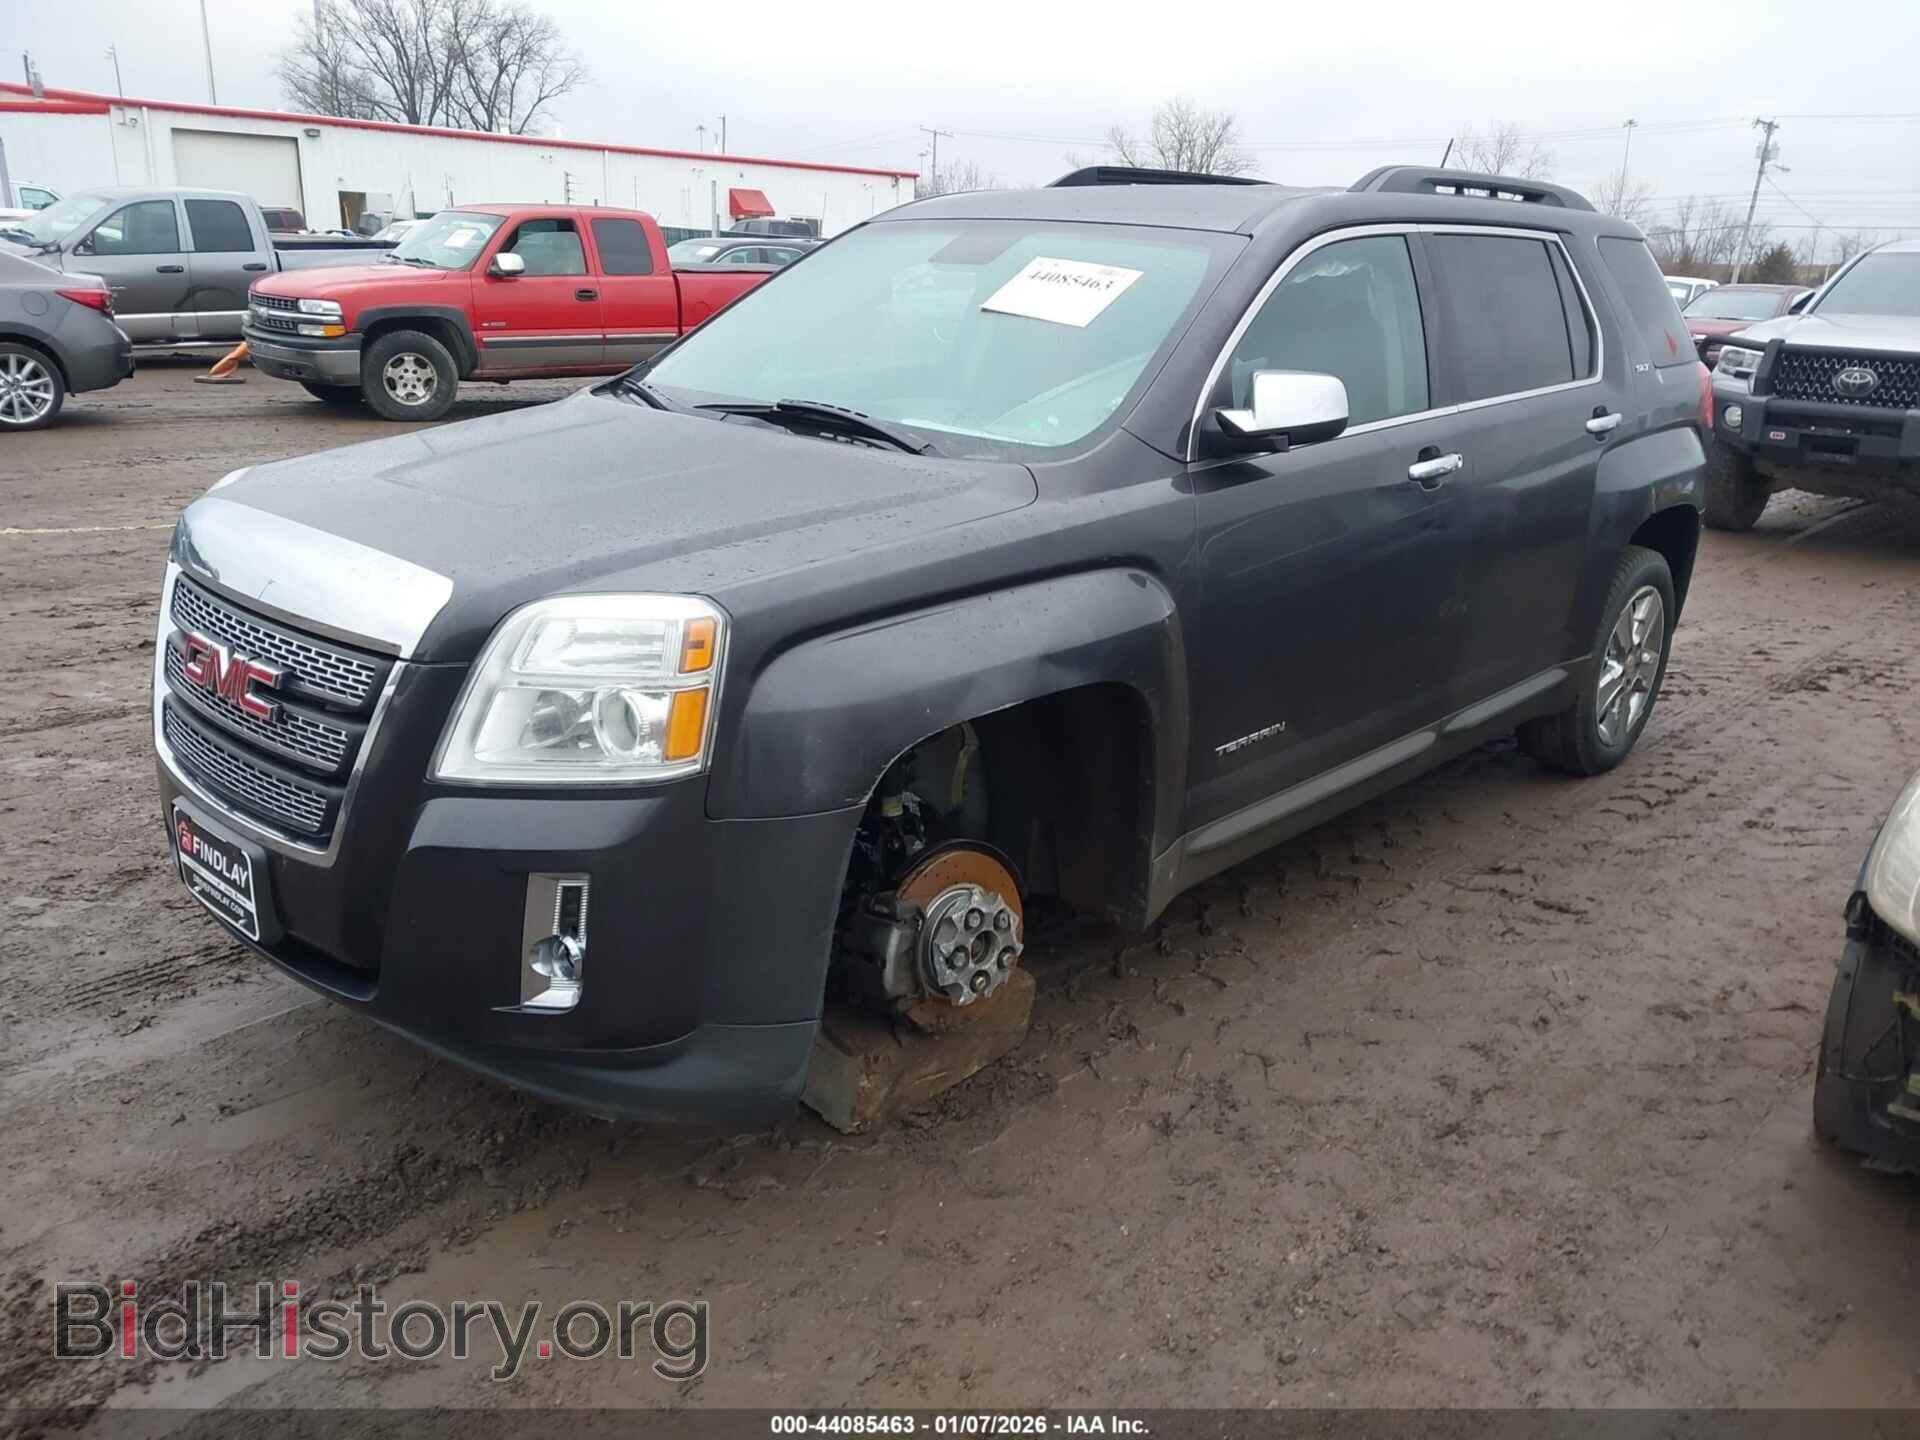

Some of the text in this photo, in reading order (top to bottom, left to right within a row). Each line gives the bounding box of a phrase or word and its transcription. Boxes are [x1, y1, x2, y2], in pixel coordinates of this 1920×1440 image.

[1029, 270, 1114, 291] 44085463
[181, 631, 284, 721] GMC
[1215, 721, 1286, 757] TERRAIN
[192, 834, 249, 889] FINDLAY
